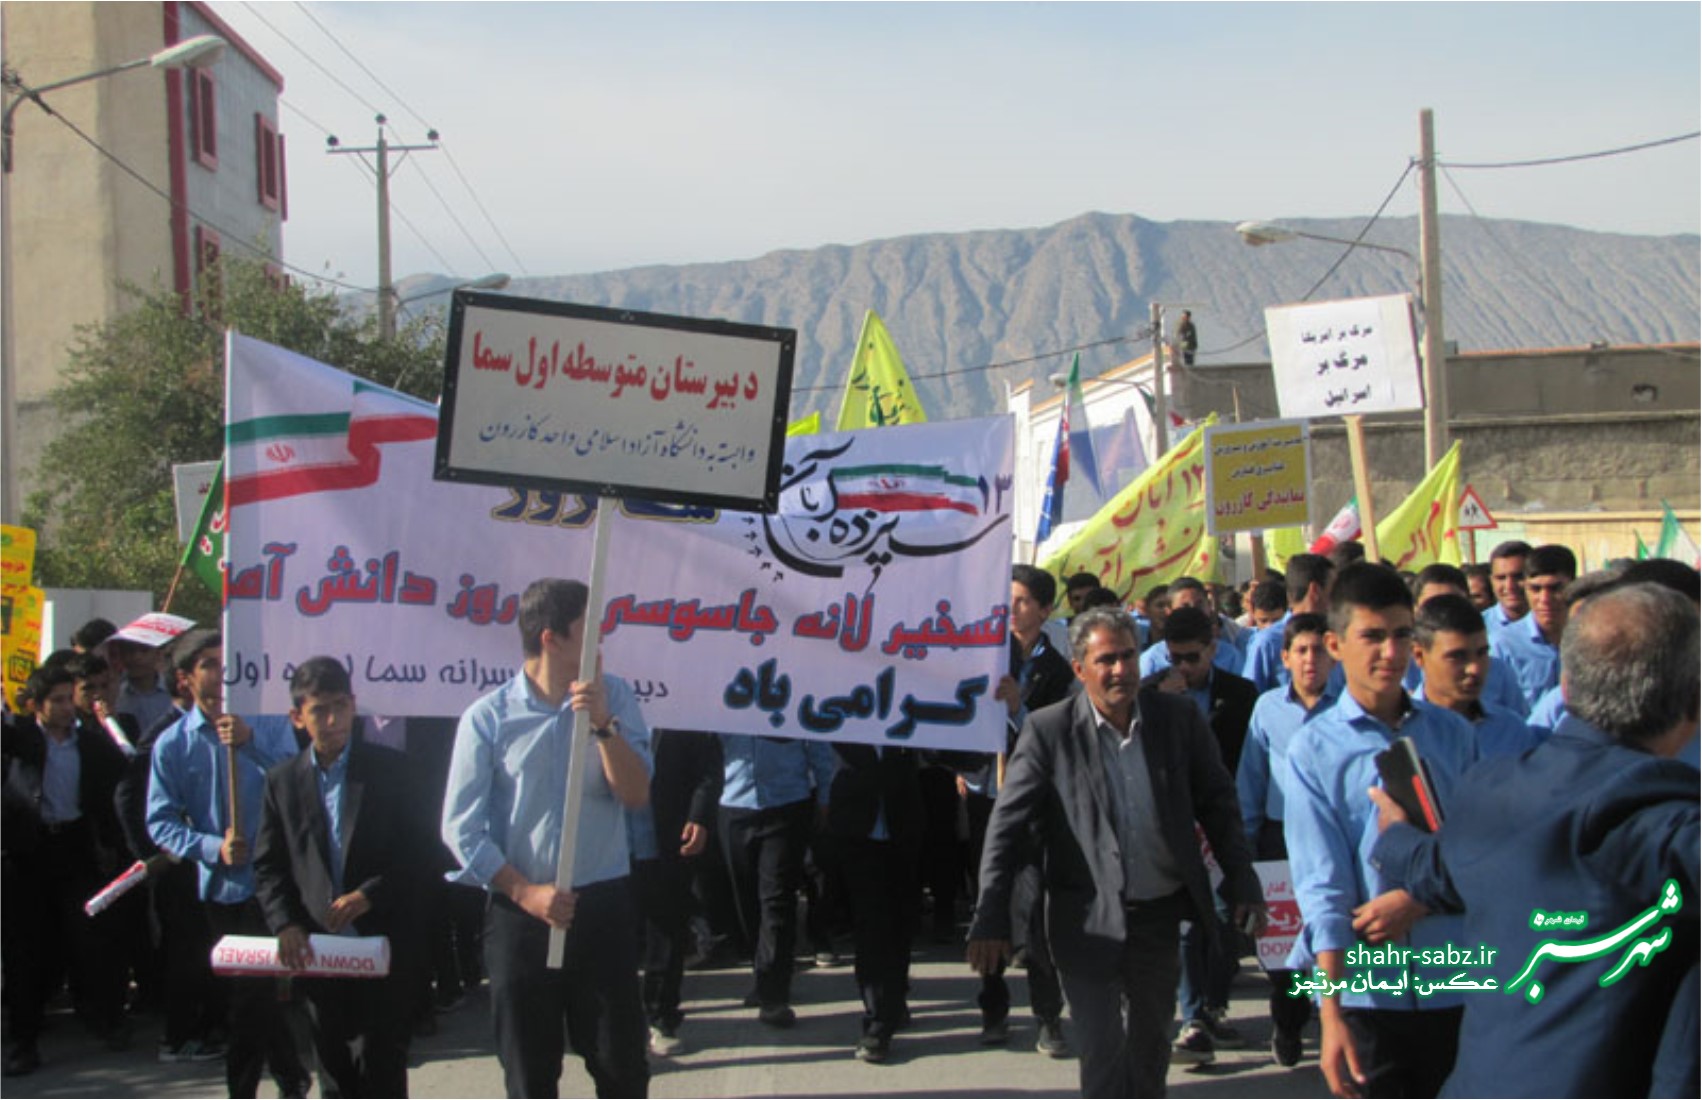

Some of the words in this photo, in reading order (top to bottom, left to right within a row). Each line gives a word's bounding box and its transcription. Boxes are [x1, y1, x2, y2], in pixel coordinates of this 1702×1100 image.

[472, 330, 513, 371] سما
[514, 336, 560, 389] اول
[561, 341, 647, 398] متوسطه
[1333, 350, 1369, 370] مرگ
[649, 354, 759, 409] دبیرستان
[478, 413, 552, 442] کازرون
[540, 429, 577, 446] واحد
[659, 420, 706, 458] دانشگاه
[717, 441, 756, 470] وابسته
[977, 473, 1013, 515] ۱۳
[1214, 488, 1254, 517] کازرون
[296, 545, 438, 616] دانش
[447, 573, 520, 625] روز
[792, 590, 875, 652] لانه
[881, 600, 1009, 659] تسخیر
[223, 651, 271, 689] اول
[365, 654, 427, 683] سما
[722, 657, 792, 729] باد
[218, 947, 271, 966] ISRAEL
[320, 953, 377, 972] DOWN
